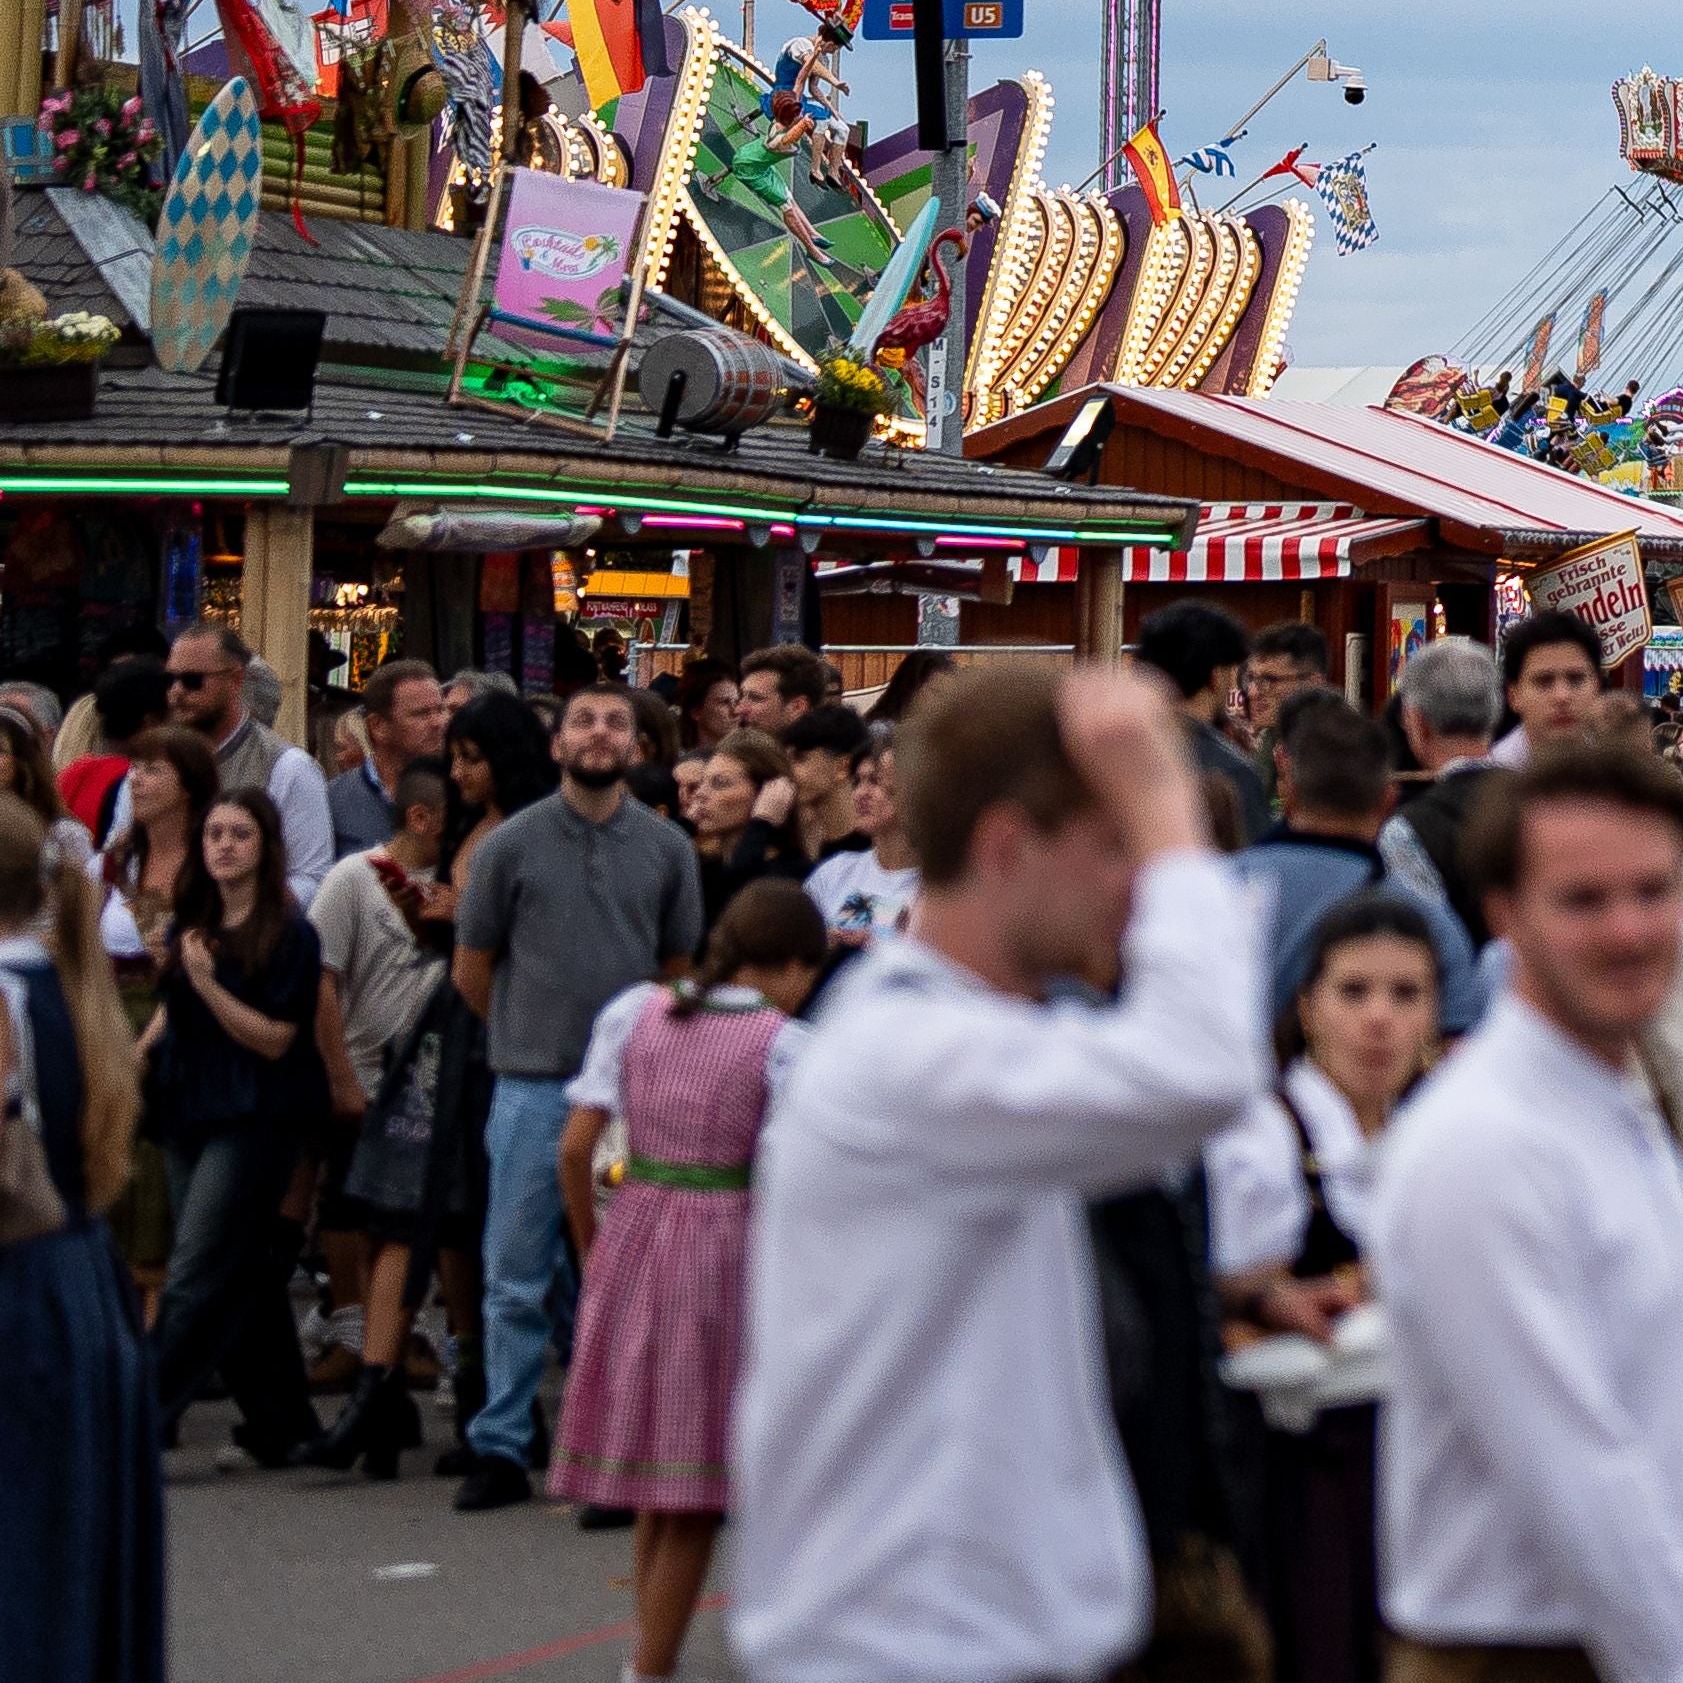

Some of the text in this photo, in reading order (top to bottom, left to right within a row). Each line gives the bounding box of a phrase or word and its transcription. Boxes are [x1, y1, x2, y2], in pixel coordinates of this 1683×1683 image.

[970, 7, 998, 24] U5
[1546, 563, 1628, 605] gebrannte
[1557, 555, 1607, 584] Frisch
[1573, 579, 1645, 628] ndeln
